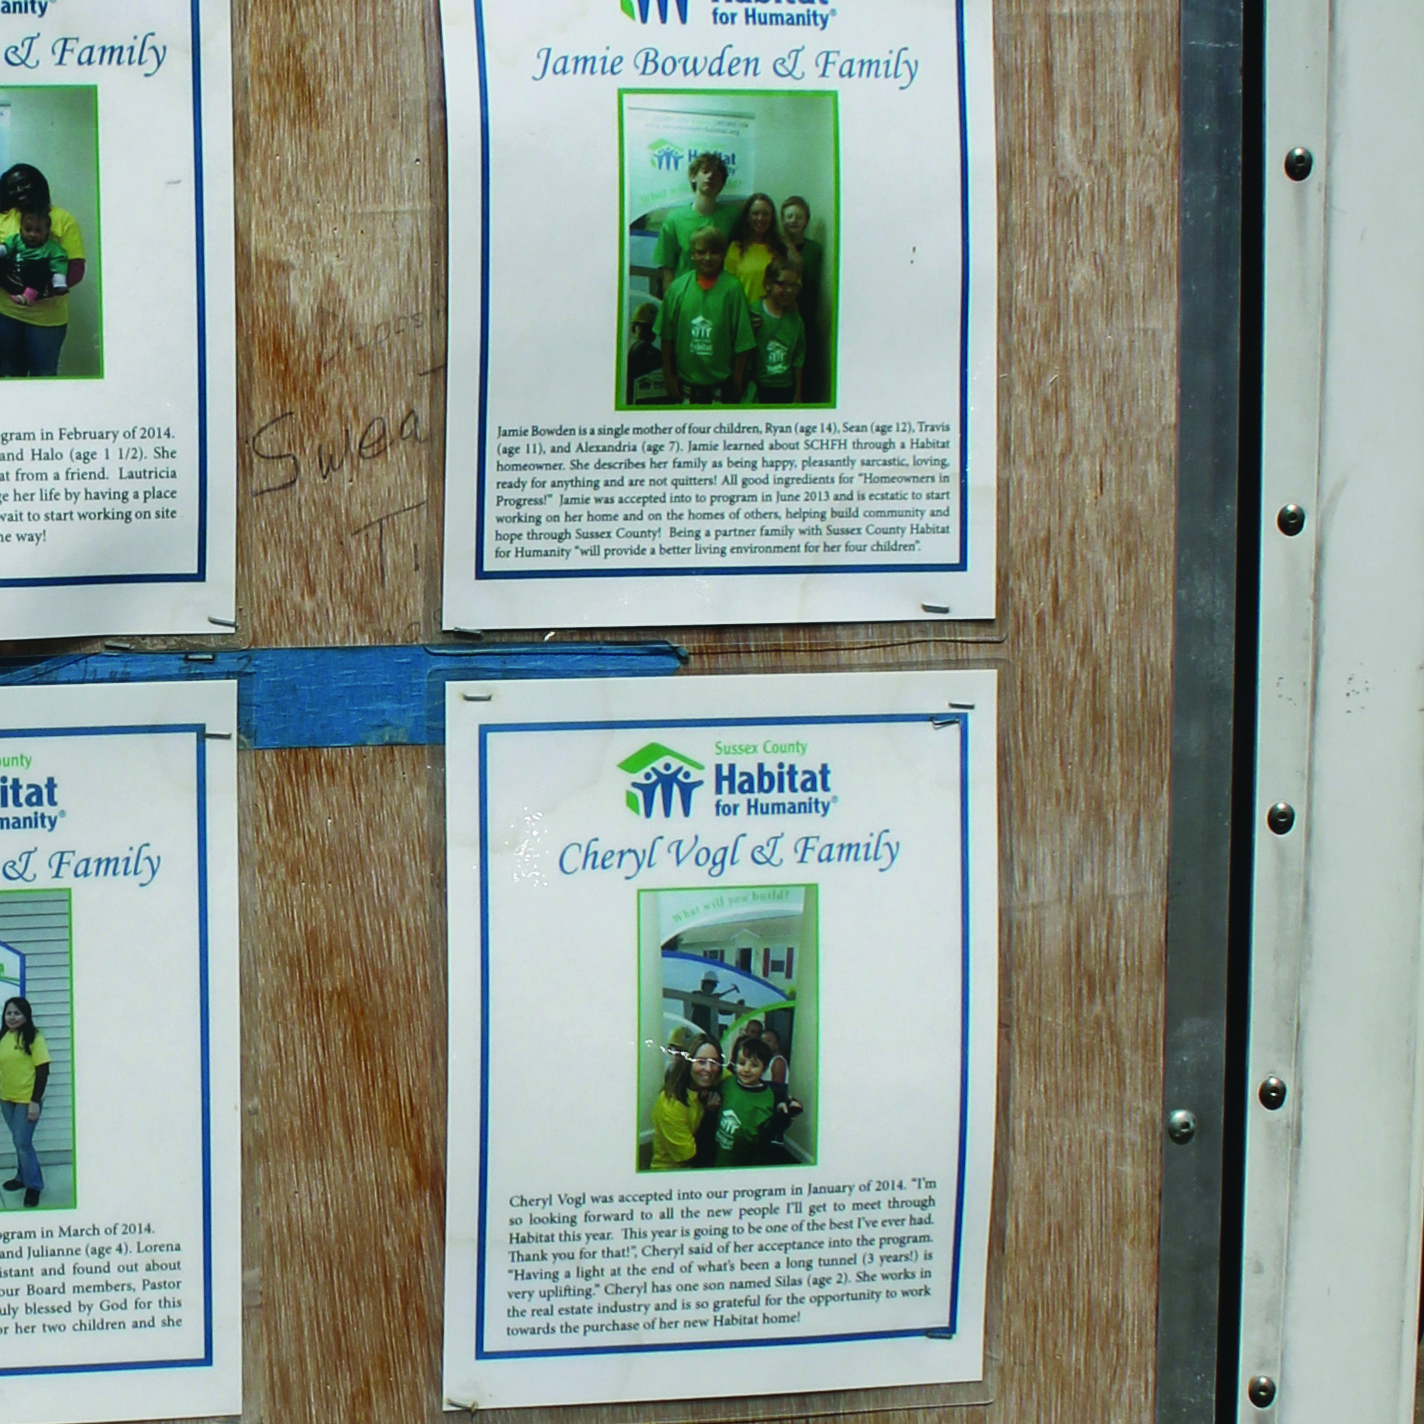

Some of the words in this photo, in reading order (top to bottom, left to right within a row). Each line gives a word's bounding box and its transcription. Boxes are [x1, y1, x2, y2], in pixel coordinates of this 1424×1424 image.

[712, 7, 738, 25] for
[51, 32, 167, 77] Family
[532, 46, 624, 81] Jamie
[634, 44, 760, 76] Bowden
[815, 47, 919, 90] Family
[715, 741, 758, 755] Sussex
[763, 740, 808, 756] County
[715, 762, 831, 795] Habitat
[715, 799, 740, 816] for
[48, 843, 161, 887] Family
[559, 836, 664, 880] Cheryl
[668, 833, 747, 877] Vogl
[794, 829, 900, 872] Family
